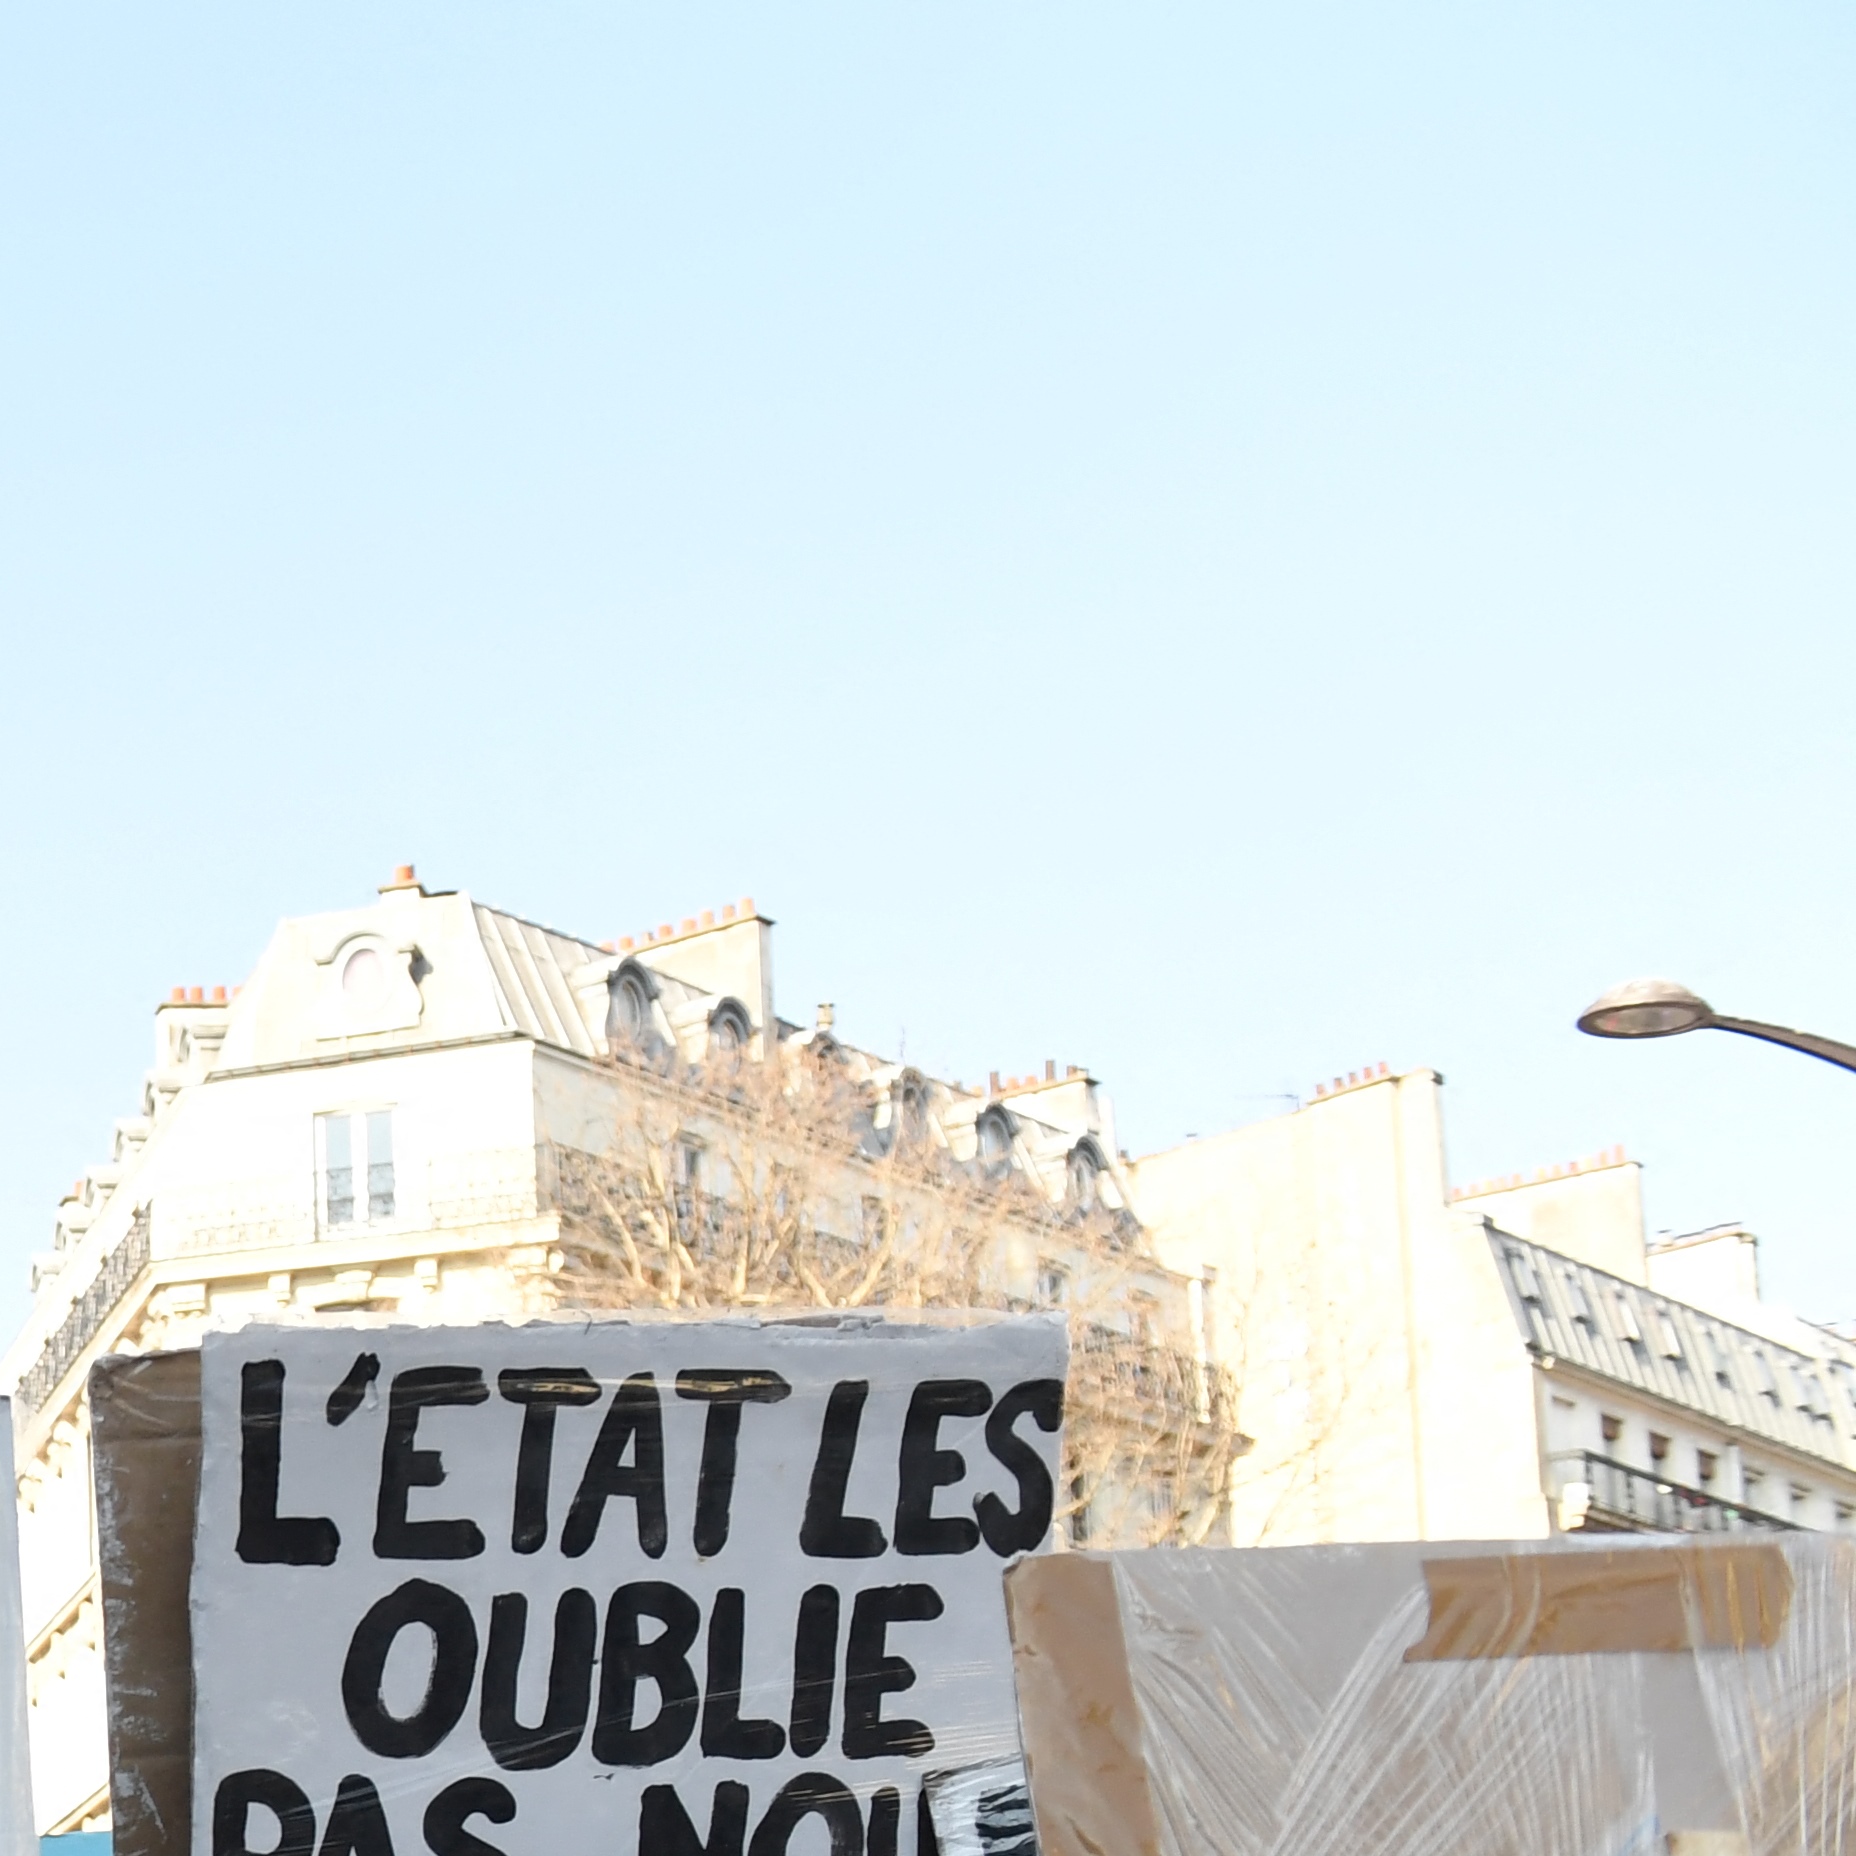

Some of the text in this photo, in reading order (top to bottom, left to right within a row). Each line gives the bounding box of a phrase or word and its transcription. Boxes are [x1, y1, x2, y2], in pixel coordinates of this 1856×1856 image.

[234, 1353, 1063, 1566] L'ETAT LES
[340, 1578, 944, 1771] OUBLIE
